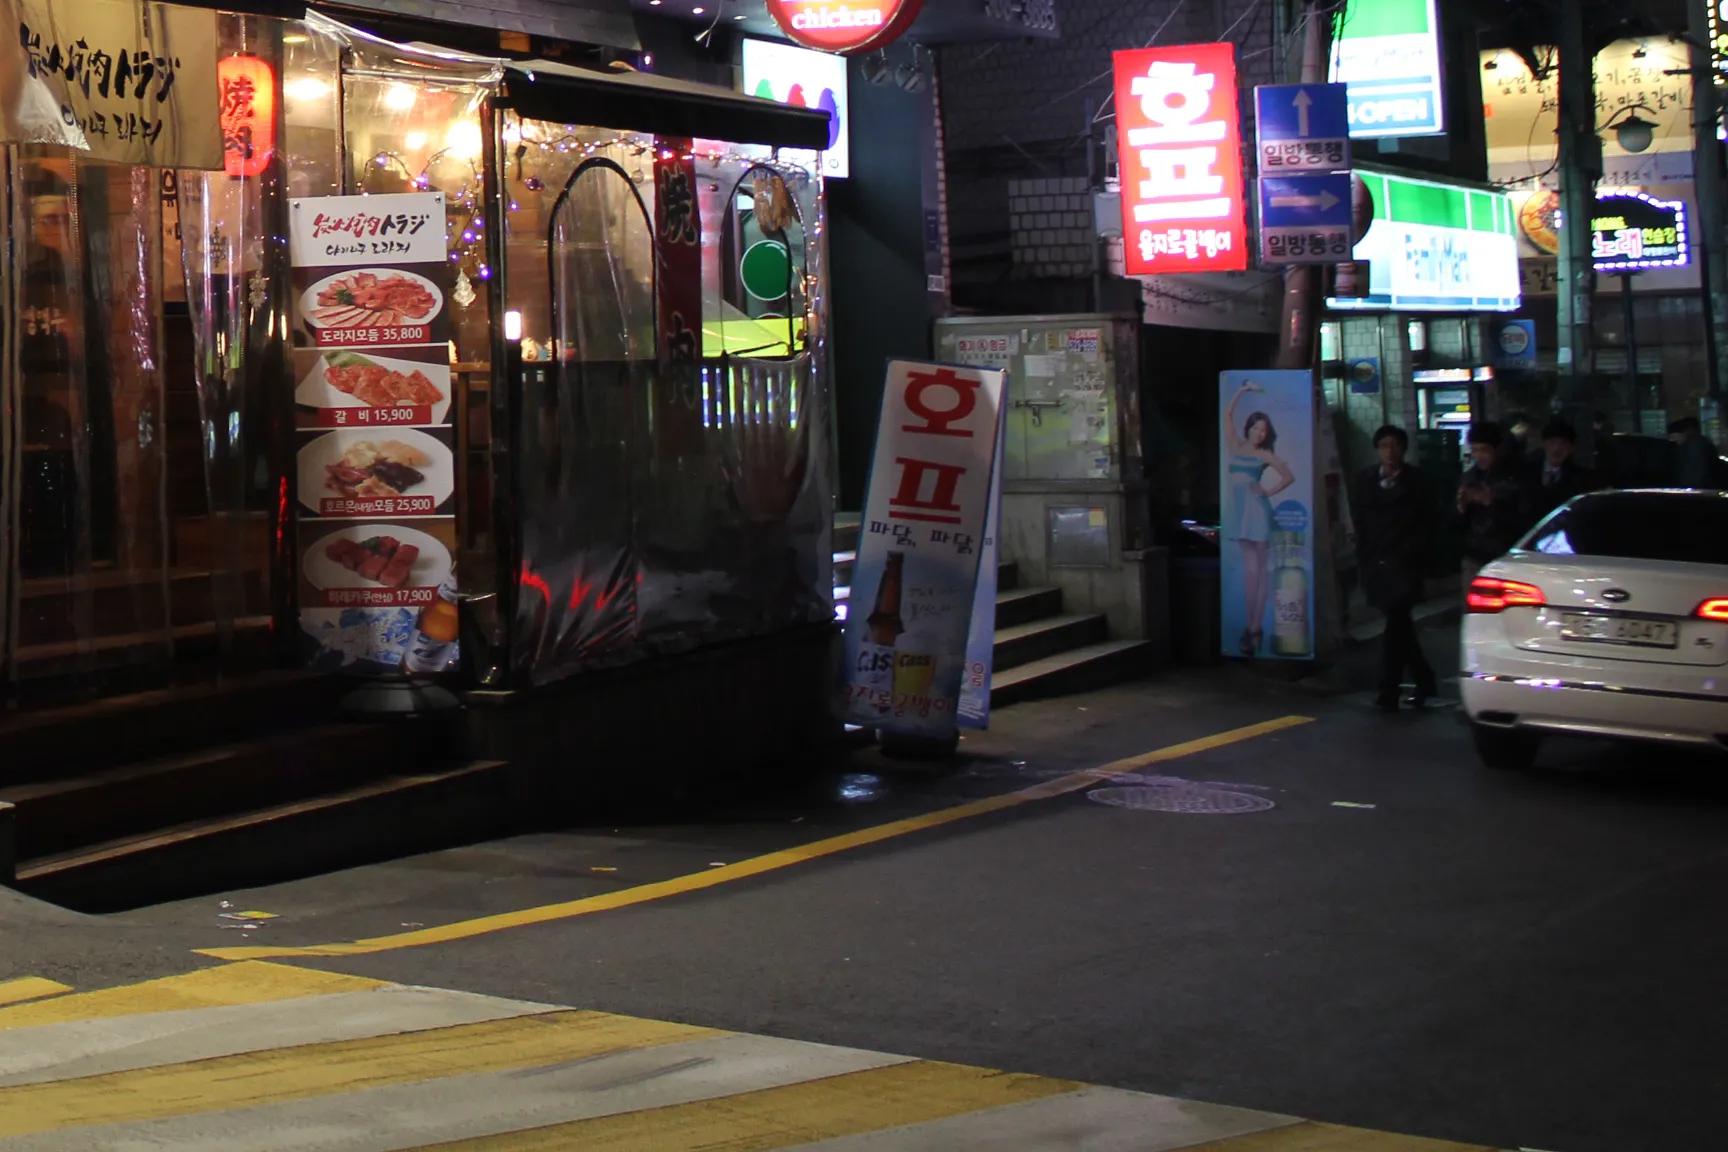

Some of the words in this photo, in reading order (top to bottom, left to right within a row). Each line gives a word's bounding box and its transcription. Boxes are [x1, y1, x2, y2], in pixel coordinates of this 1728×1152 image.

[791, 5, 882, 30] chicken
[1127, 60, 1232, 223] 호프
[1264, 141, 1343, 166] 일방통행
[1137, 228, 1233, 261] 을지로골뱅이
[1267, 232, 1348, 257] 일방통행
[1591, 228, 1642, 259] 노래
[321, 329, 380, 343] 도라지모듬
[382, 327, 423, 342] 35,800
[374, 408, 414, 422] 15,900
[888, 368, 982, 525] 호프
[396, 498, 431, 512] 25,900
[396, 589, 433, 603] 17,900
